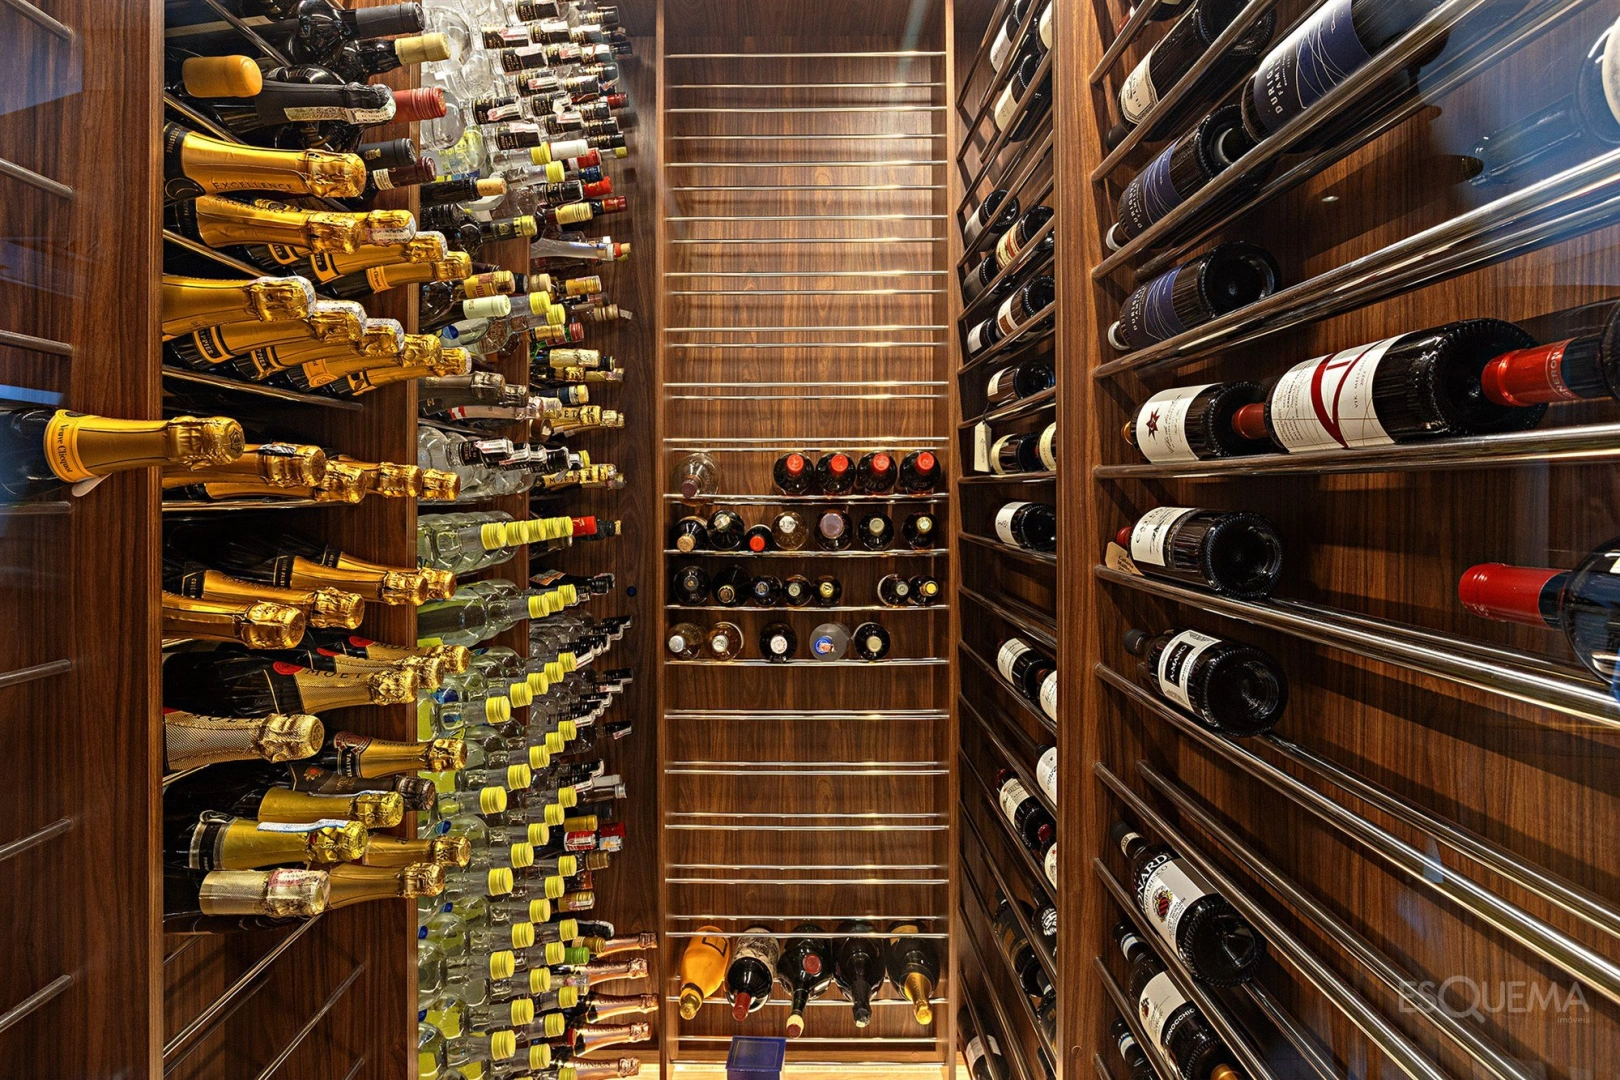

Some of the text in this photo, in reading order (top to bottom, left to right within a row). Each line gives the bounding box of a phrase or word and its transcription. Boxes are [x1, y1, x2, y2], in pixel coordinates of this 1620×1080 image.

[212, 181, 294, 191] EXCELLENCE
[57, 424, 73, 473] Veuve Clicquot
[377, 740, 420, 748] TAITTINGER
